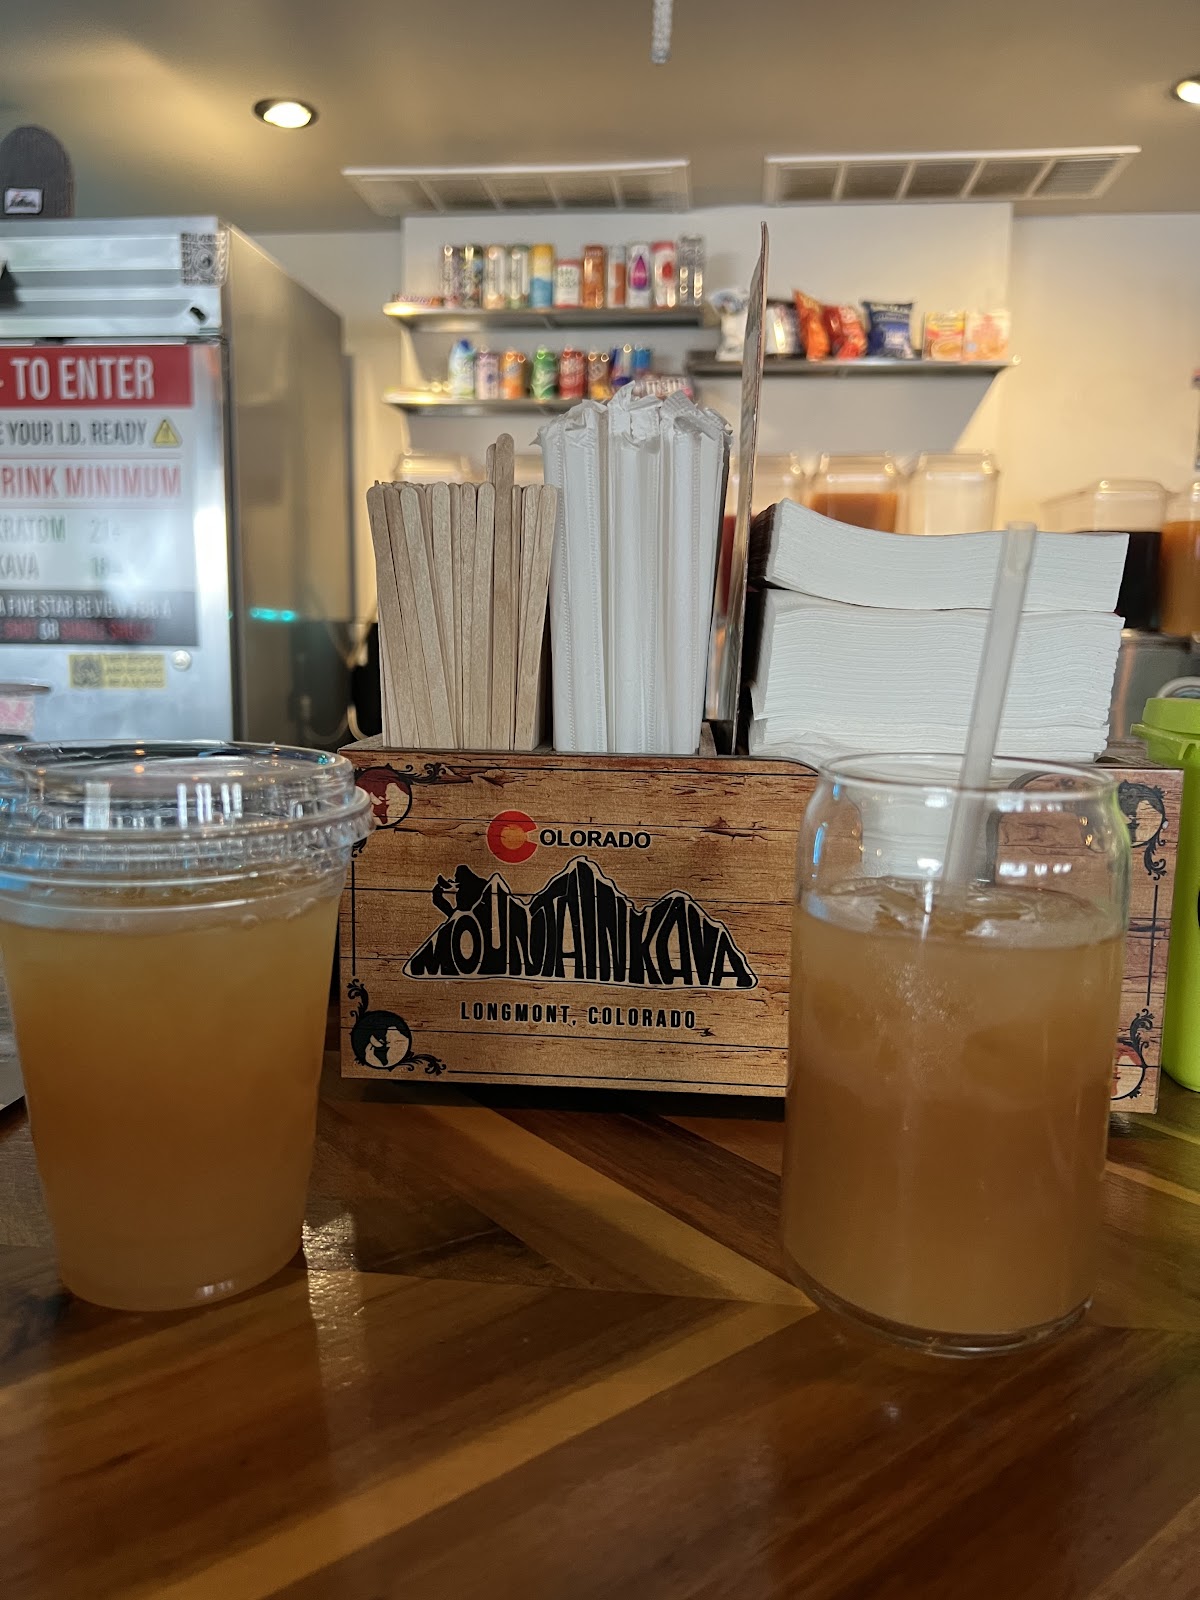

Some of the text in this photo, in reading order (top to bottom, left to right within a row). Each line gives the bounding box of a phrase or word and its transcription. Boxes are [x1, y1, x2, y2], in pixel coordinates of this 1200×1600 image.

[10, 356, 155, 400] TO ENTER
[7, 419, 53, 446] YOUR
[90, 419, 147, 446] READY
[65, 464, 182, 498] MINIMUM
[8, 594, 38, 618] FIVE
[38, 594, 74, 618] STAR
[460, 1000, 696, 1029] LONGMONT, COLORADO
